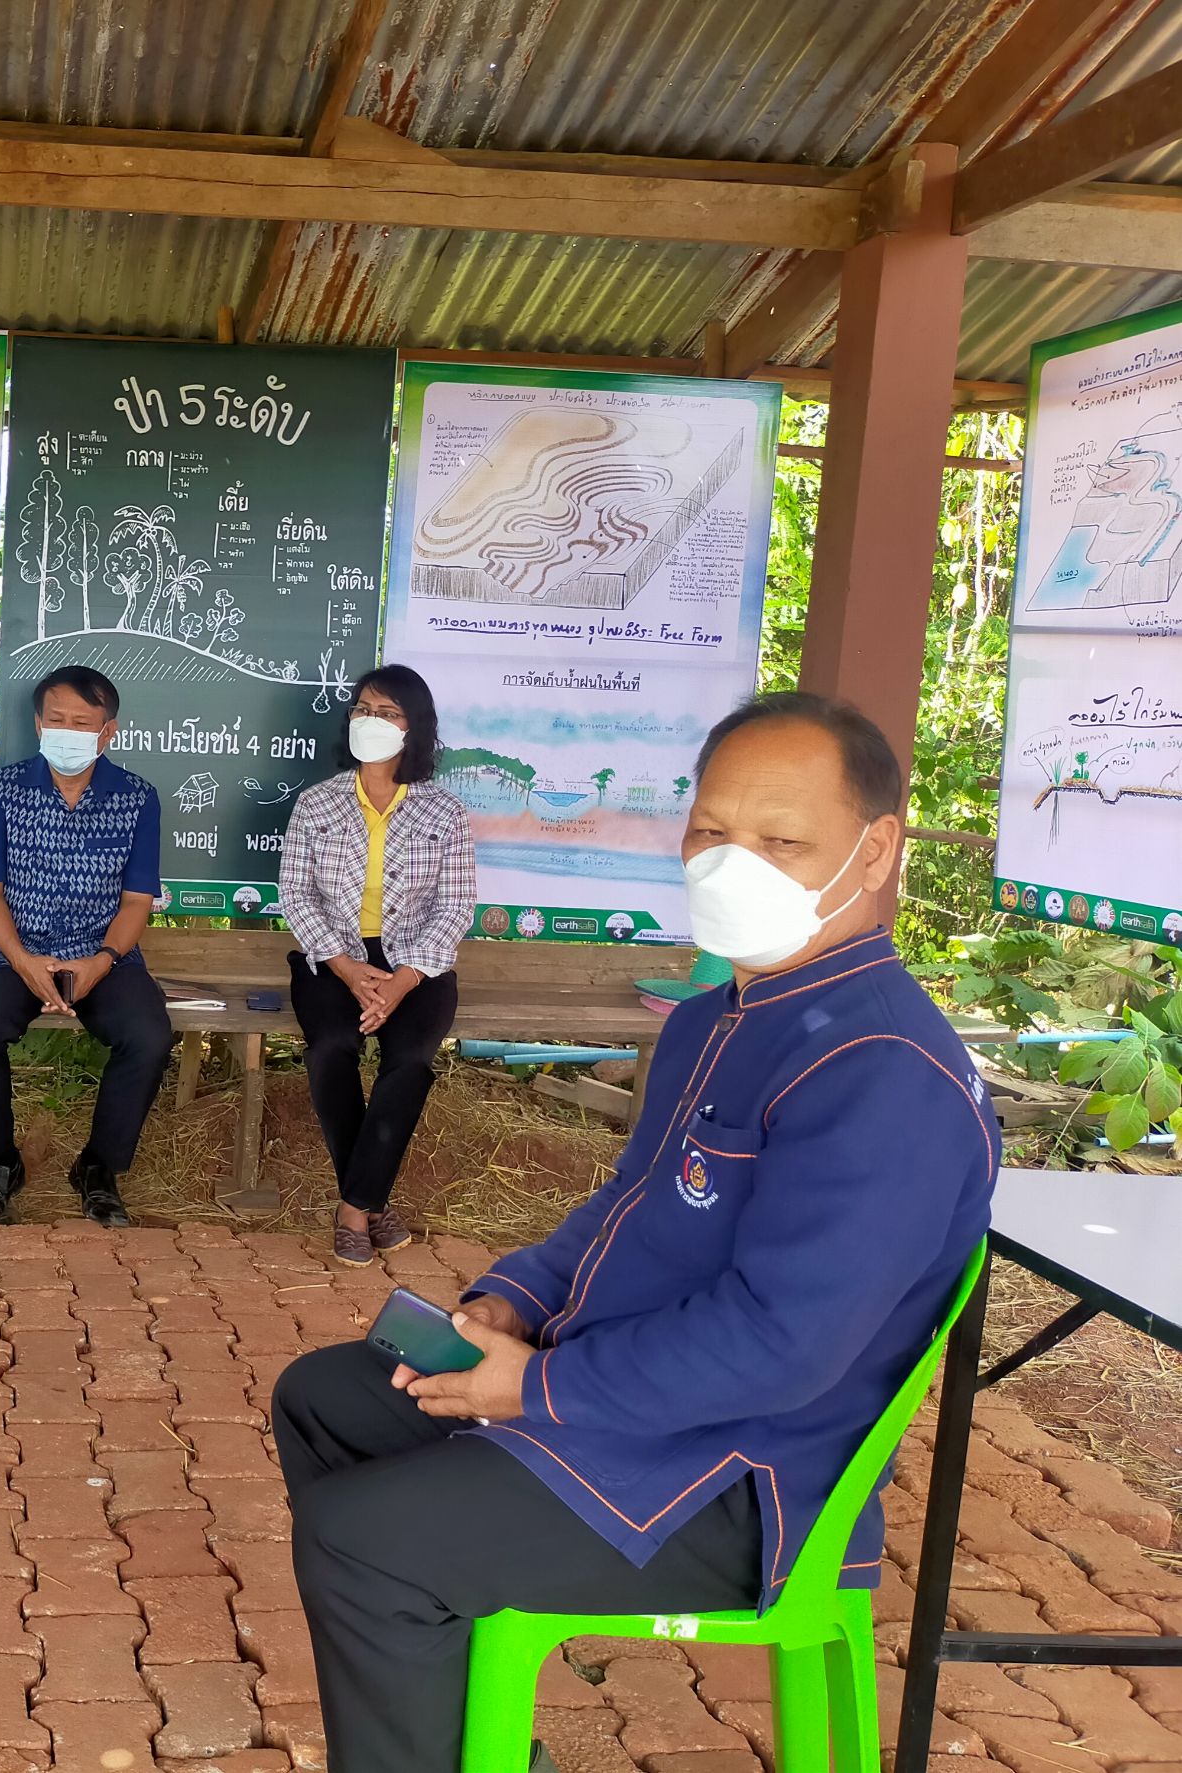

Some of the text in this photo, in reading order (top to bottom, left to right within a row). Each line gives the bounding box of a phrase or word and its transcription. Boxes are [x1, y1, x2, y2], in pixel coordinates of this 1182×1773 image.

[114, 375, 312, 447] ป่า 5 ระดับ
[37, 430, 59, 465] สูง
[81, 455, 94, 466] สัก
[126, 450, 165, 468] กลาง
[180, 451, 203, 461] มะม่วง
[180, 464, 209, 474] มะพร้าว
[218, 480, 249, 512] เตี้ย
[276, 512, 328, 541] เรี่ยดิน
[228, 550, 245, 558] พริก
[286, 543, 311, 553] แตงโม
[286, 558, 314, 569] ฟักทอง
[327, 564, 375, 591] ใต้ดิน
[342, 599, 357, 611] มัน
[659, 622, 684, 640] Free
[691, 626, 723, 644] Form
[503, 669, 641, 690] การจัดเก็บน้ำฝนในพื้นที่
[158, 716, 241, 755] ประโยชน์
[246, 735, 261, 756] 4
[271, 729, 316, 760] อย่าง
[173, 826, 218, 857] พออยู่
[182, 894, 223, 905] earthsafe
[555, 920, 596, 931] earthsafe
[1122, 916, 1154, 930] earthsafe
